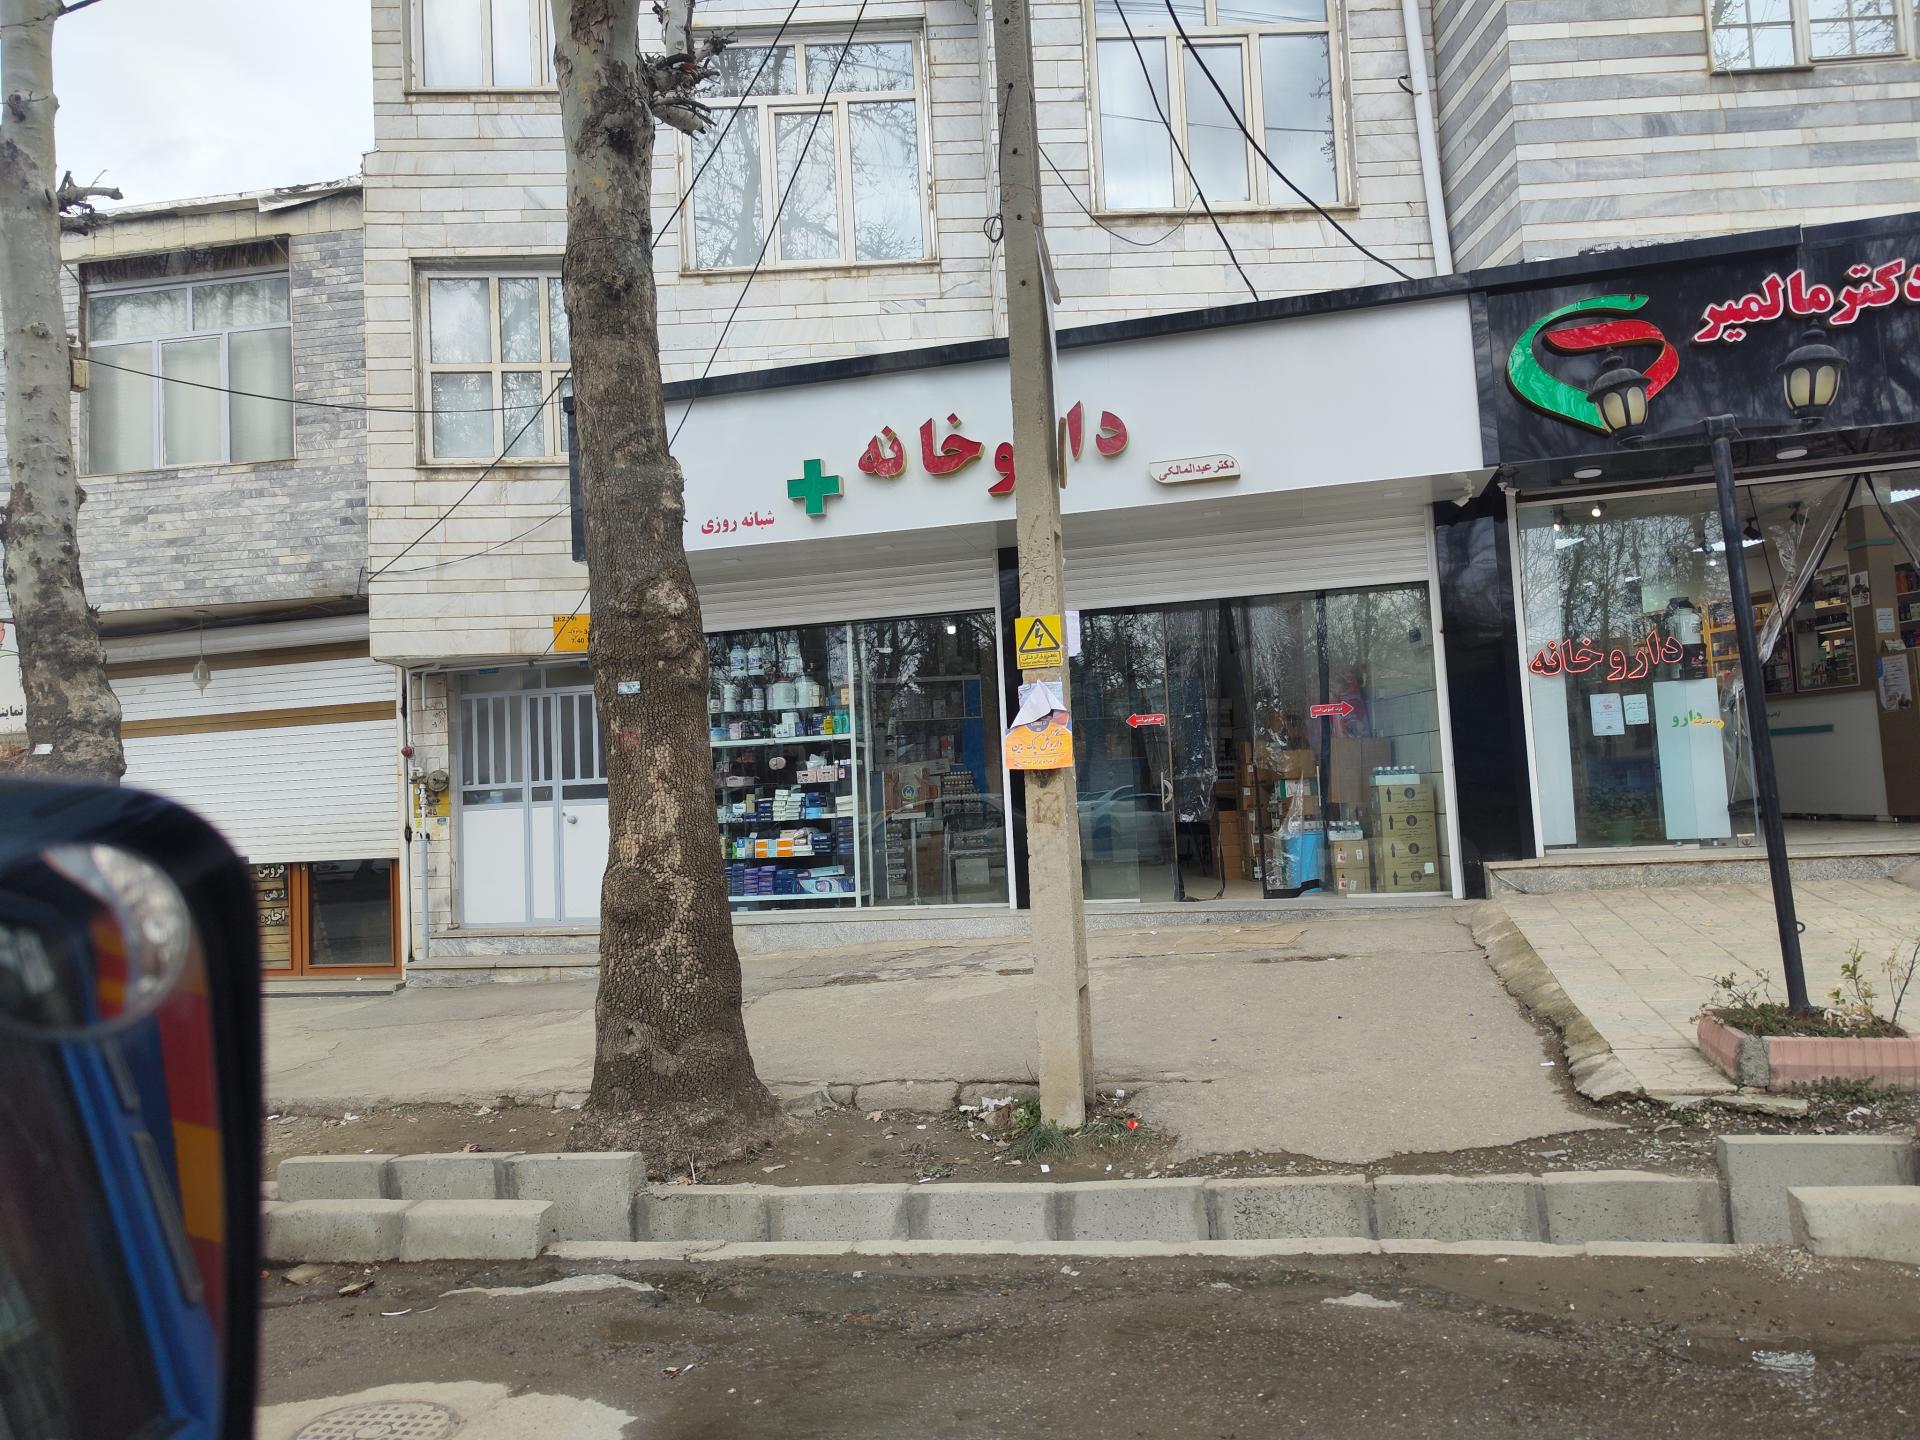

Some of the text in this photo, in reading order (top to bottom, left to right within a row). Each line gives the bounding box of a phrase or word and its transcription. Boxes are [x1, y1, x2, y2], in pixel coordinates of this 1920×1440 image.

[1694, 257, 1920, 342] دکتر مالمیر
[857, 399, 1130, 498] داوخانه
[1158, 459, 1235, 481] دکتر عبدالمالکی
[701, 509, 775, 535] شبانه روزی
[1671, 709, 1703, 728] دارو
[258, 863, 285, 878] فروش
[264, 888, 286, 902] رهن
[260, 908, 286, 926] اجاره
